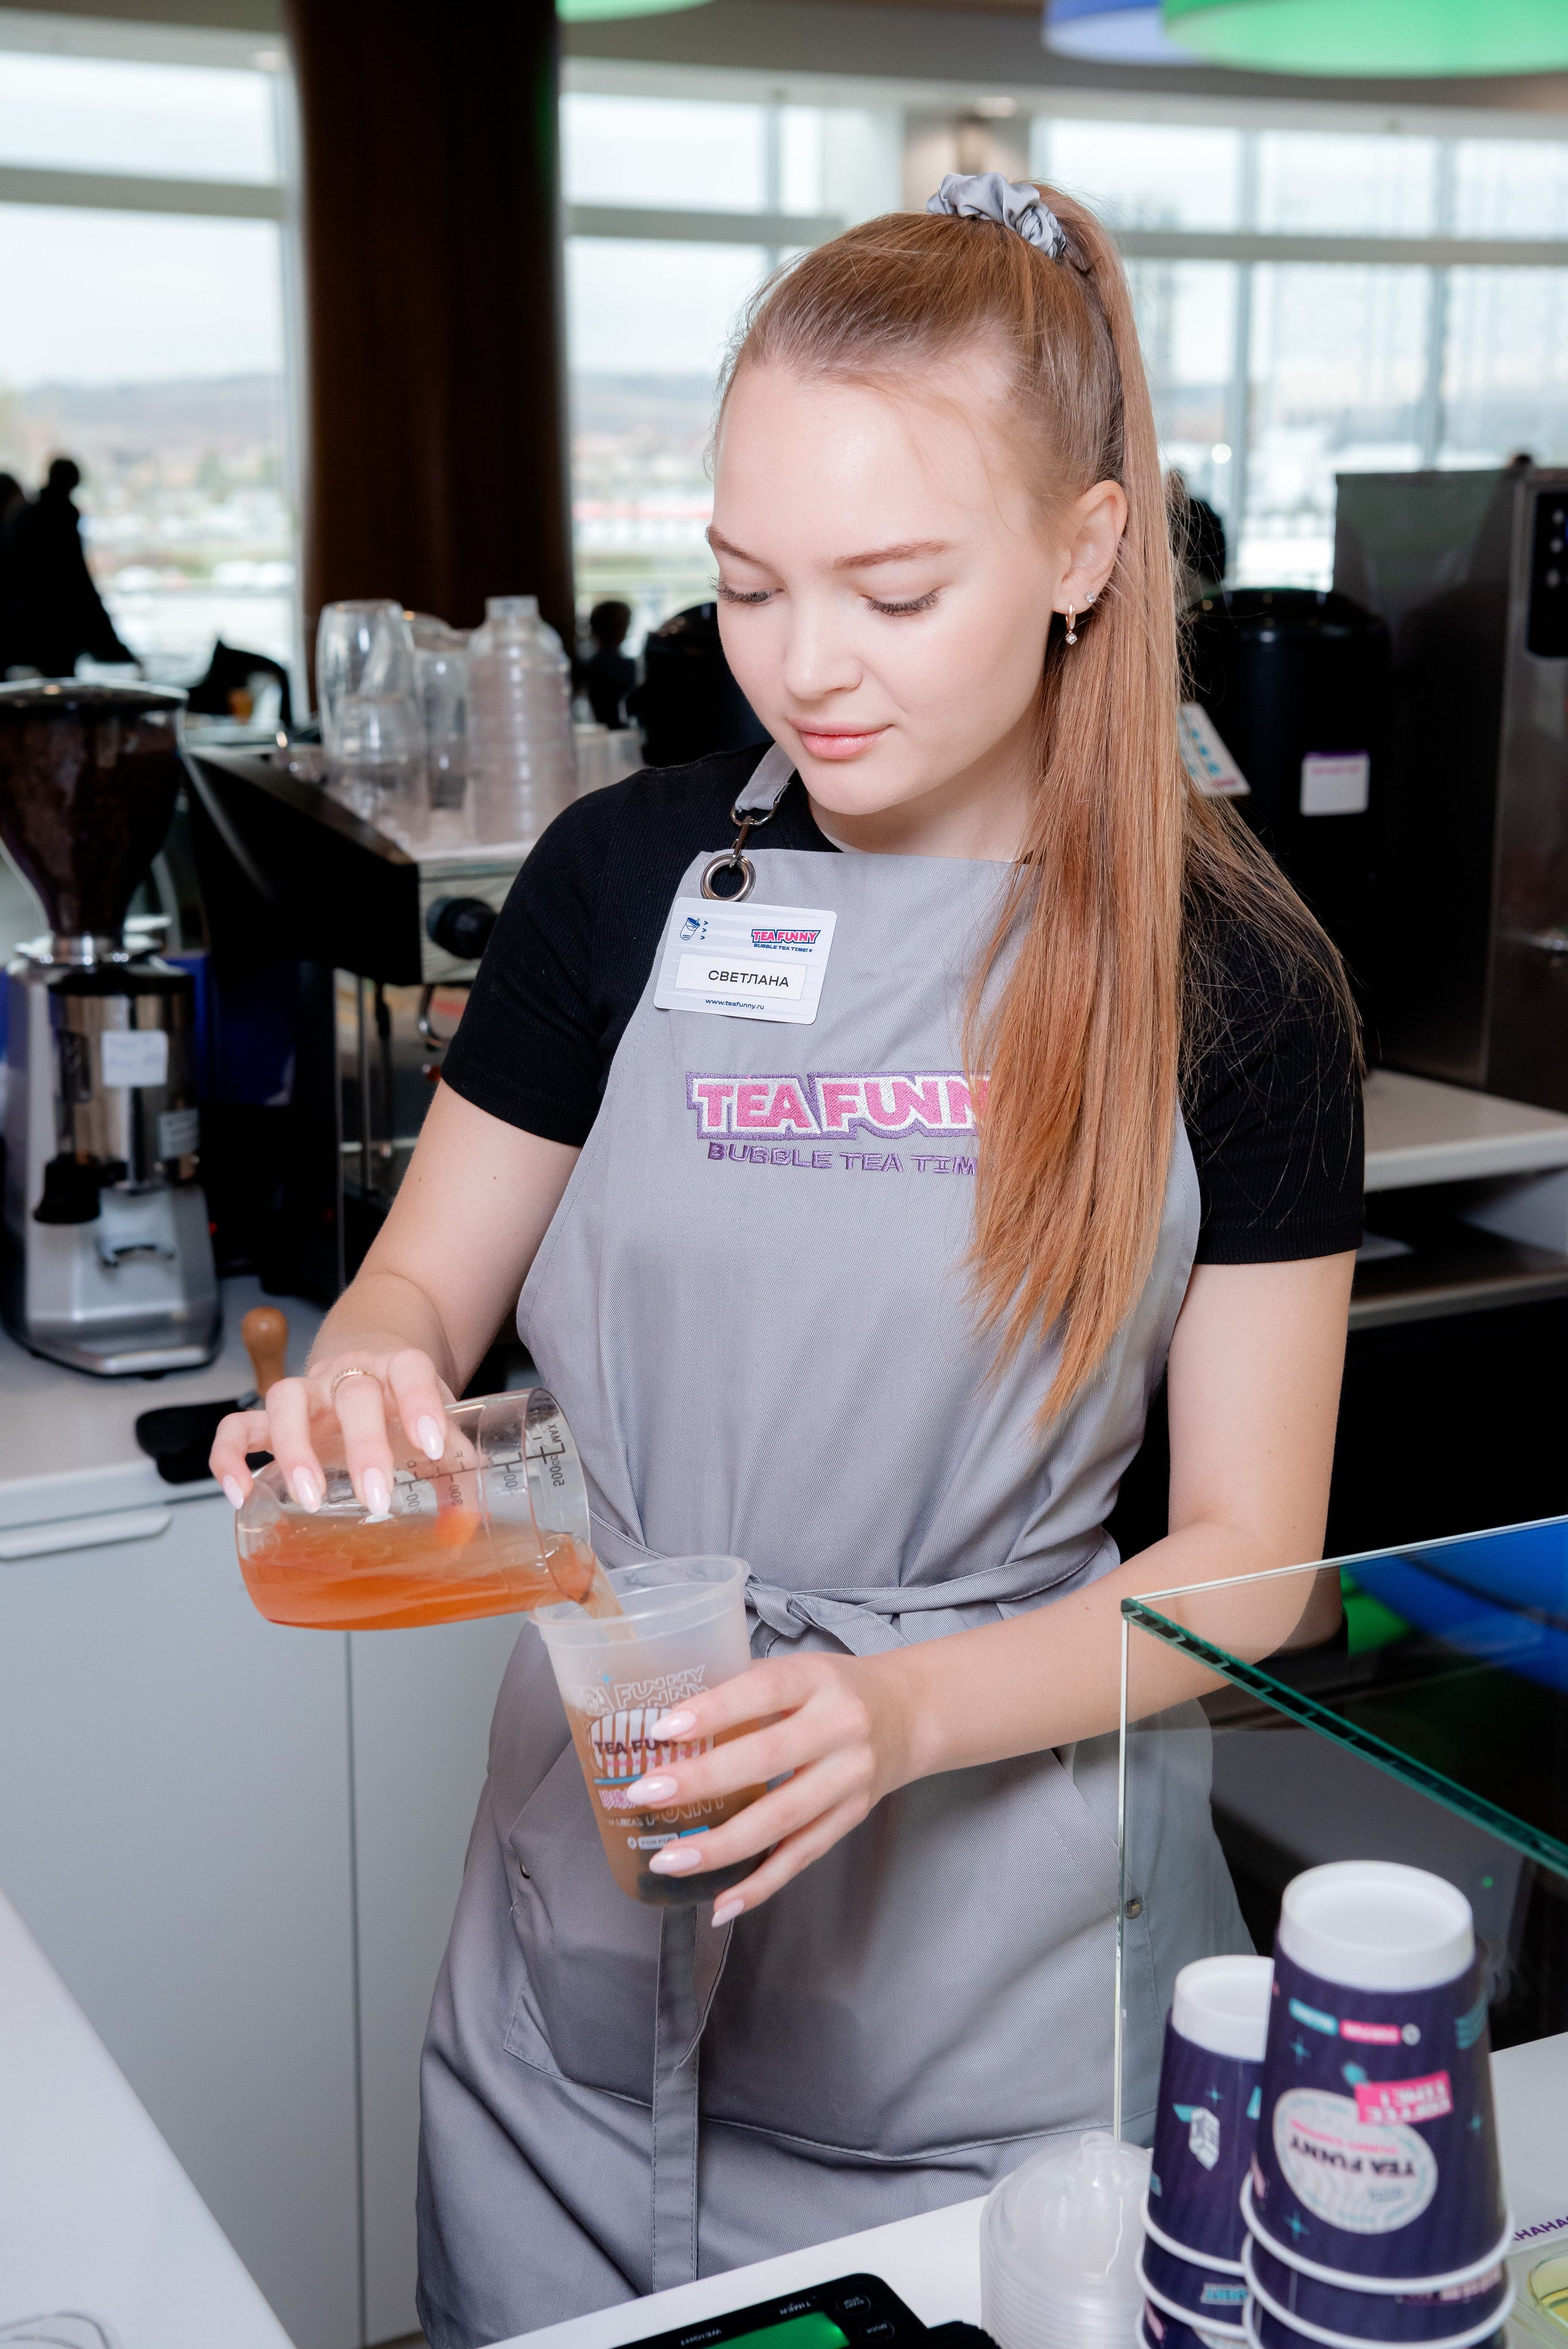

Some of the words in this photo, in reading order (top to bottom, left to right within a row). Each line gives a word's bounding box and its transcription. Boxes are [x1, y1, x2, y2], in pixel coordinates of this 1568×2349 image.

[752, 930, 775, 943] TEA
[776, 930, 820, 943] FUNNY
[708, 970, 789, 987] СВЕТЛАНА
[705, 998, 764, 1009] www.teafunny.ru
[693, 1078, 820, 1134] TEA
[815, 1076, 989, 1135] FUNN
[707, 1142, 832, 1169] BUBBLE
[839, 1152, 903, 1172] TEA
[910, 1155, 978, 1176] TIM
[594, 1741, 628, 1754] TEA
[1514, 2216, 1568, 2241] НАНА
